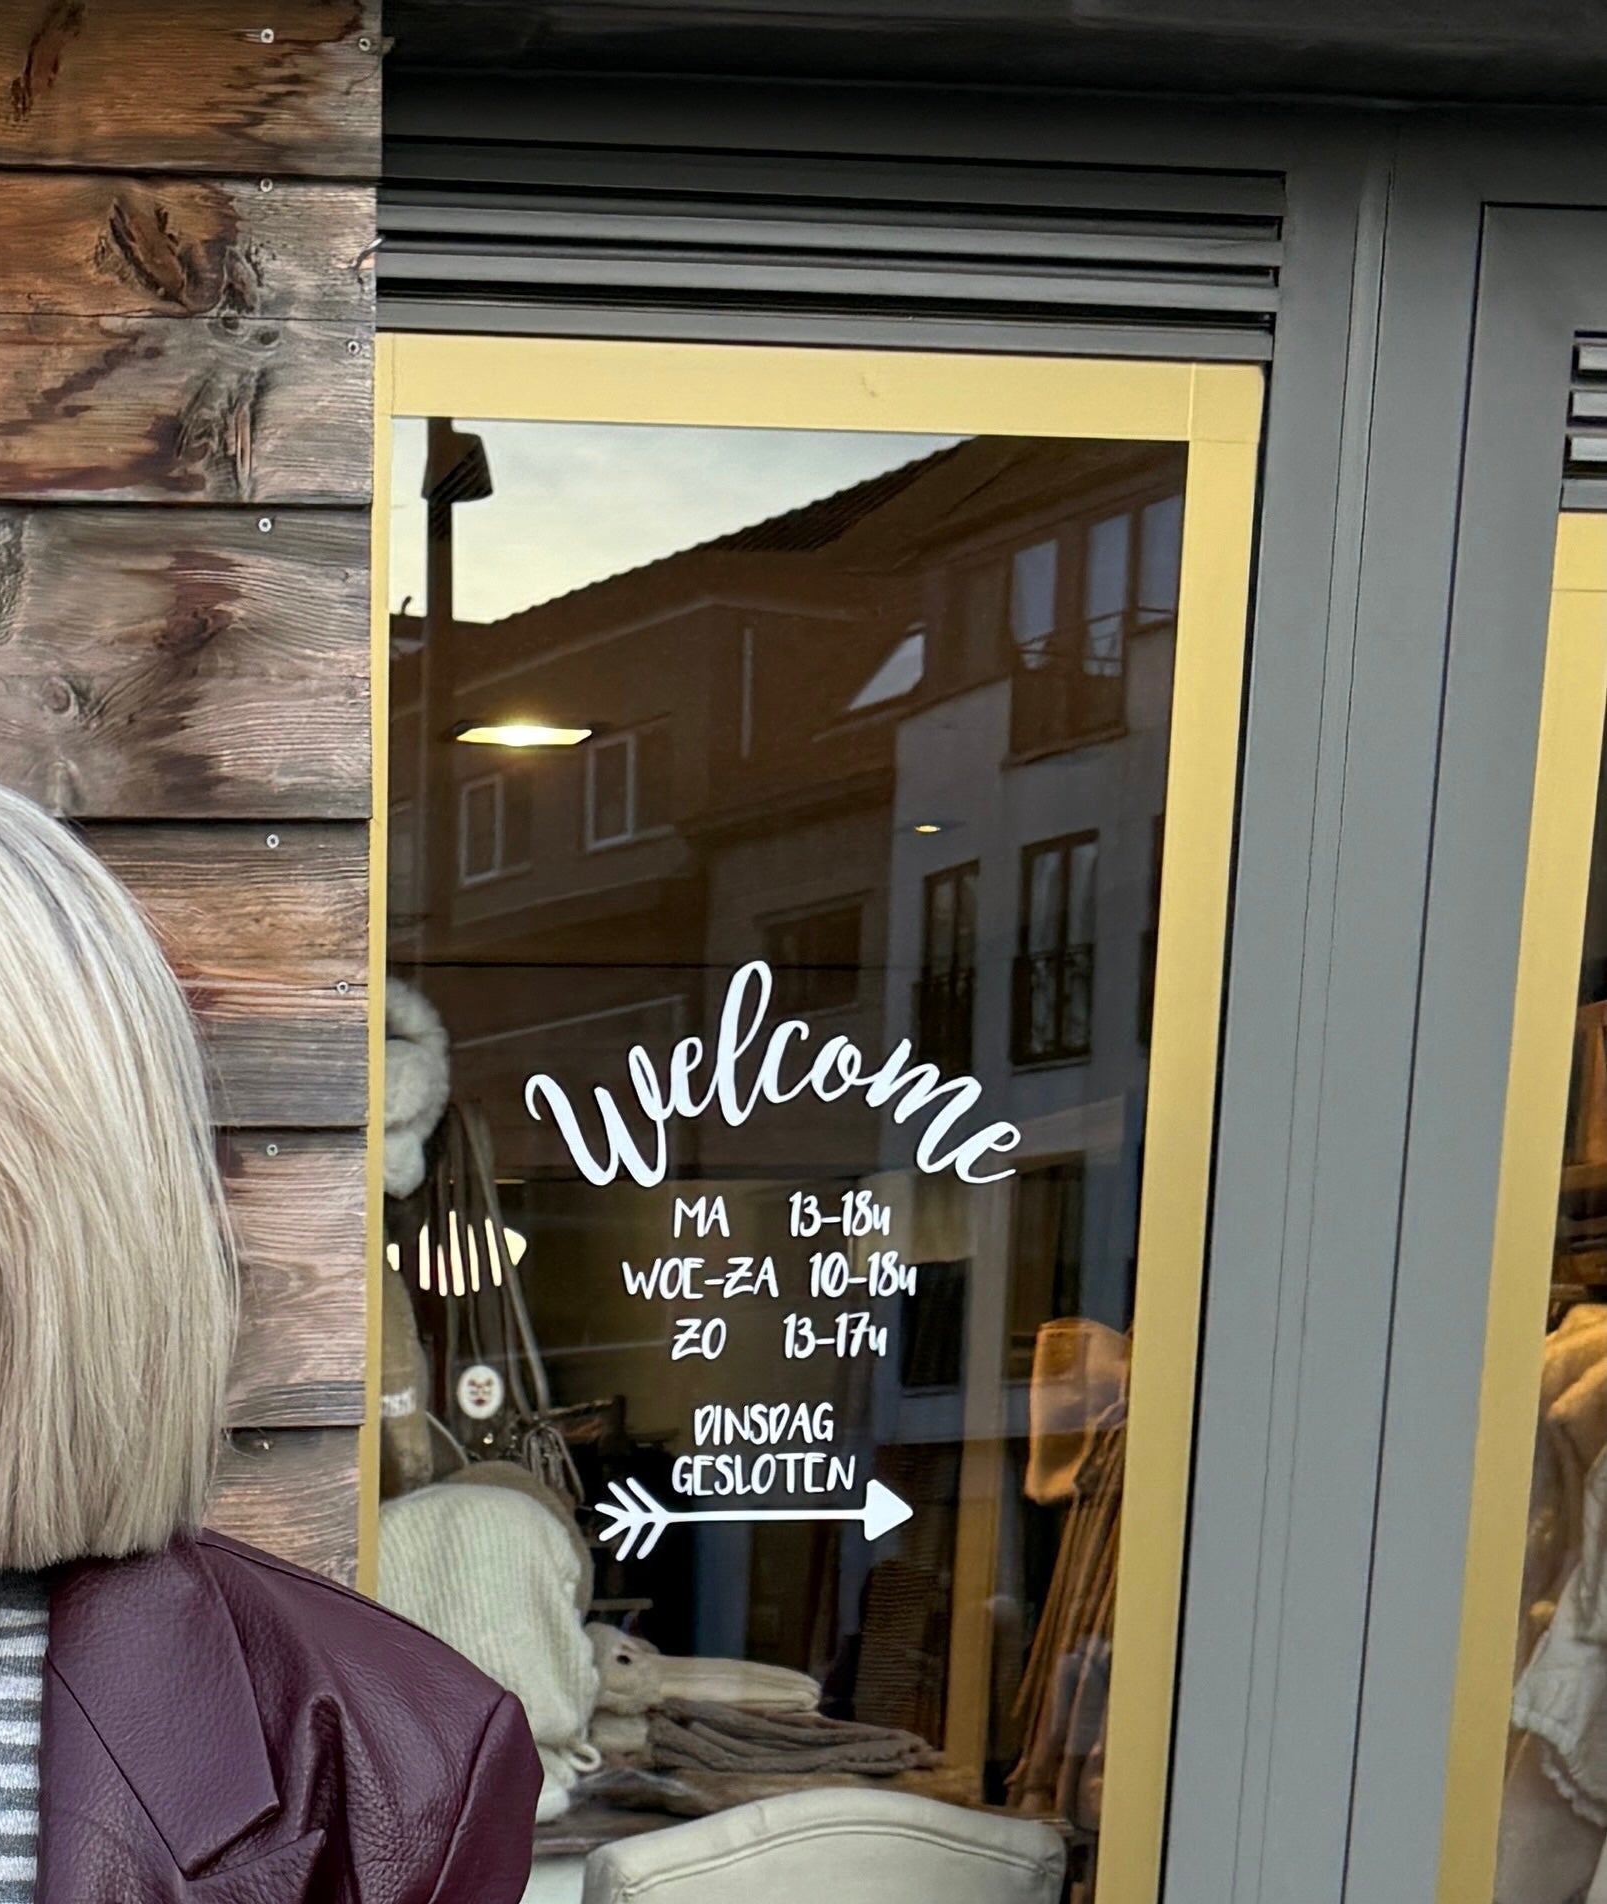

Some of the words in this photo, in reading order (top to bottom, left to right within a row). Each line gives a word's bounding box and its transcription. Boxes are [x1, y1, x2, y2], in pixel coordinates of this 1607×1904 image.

[525, 960, 1022, 1188] Welcome
[673, 1195, 730, 1238] MA
[789, 1189, 891, 1237] 13-18u
[622, 1256, 779, 1300] WOE-ZA
[809, 1250, 917, 1298] 10-18u
[671, 1317, 727, 1361] ZO
[783, 1311, 888, 1359] 13-17u
[694, 1401, 834, 1446] DINSDAG
[671, 1453, 855, 1494] GESLOTEN
